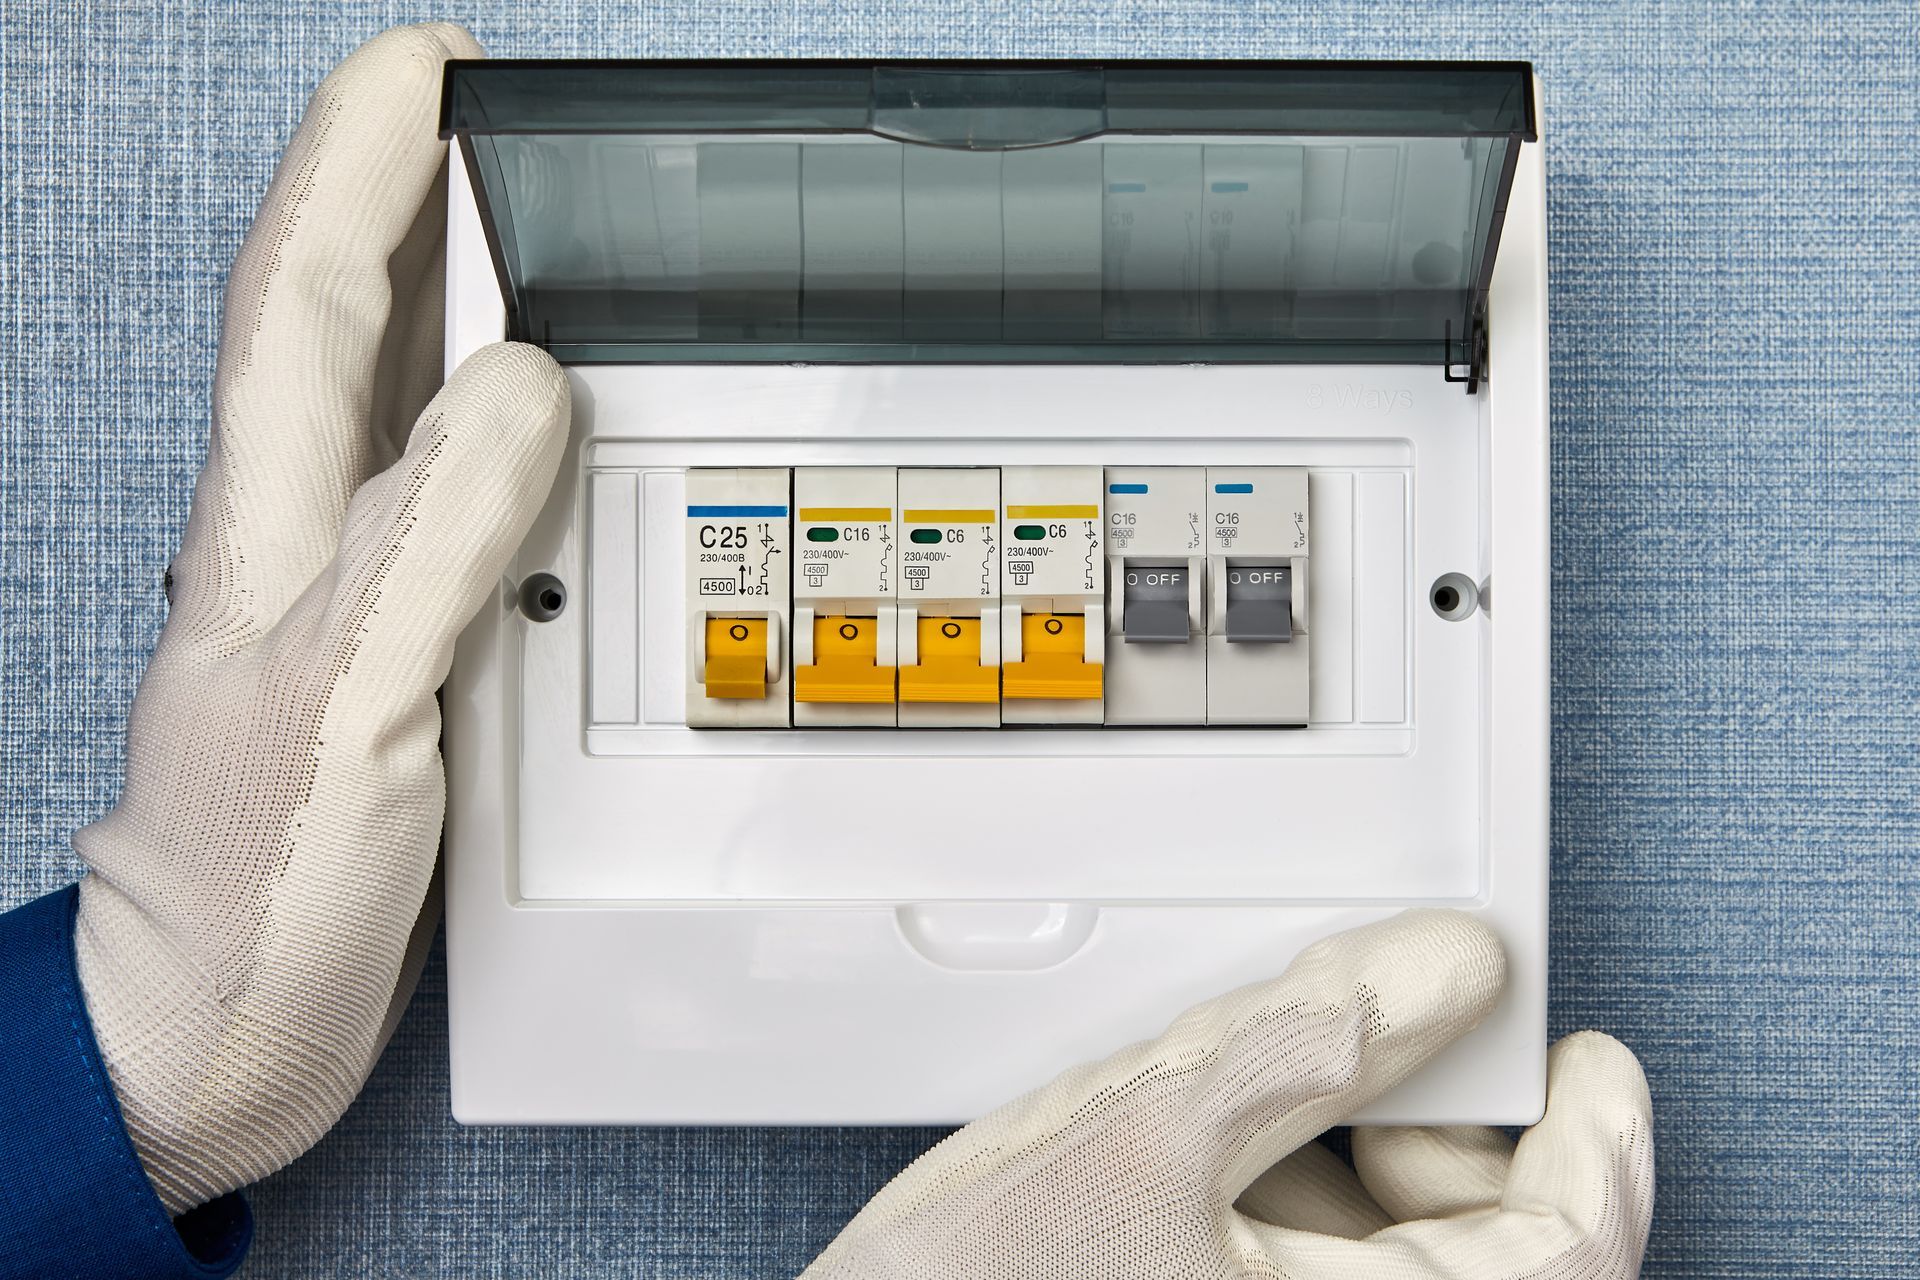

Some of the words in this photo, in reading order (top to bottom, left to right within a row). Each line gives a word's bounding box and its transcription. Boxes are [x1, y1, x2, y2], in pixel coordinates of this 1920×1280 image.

[1306, 384, 1323, 409] 8
[1334, 384, 1413, 416] Ways
[1111, 513, 1137, 525] C16
[1215, 512, 1240, 525] C16
[700, 525, 747, 548] C25
[843, 527, 870, 541] C16
[947, 529, 964, 544] C6
[1049, 524, 1067, 538] C6
[1112, 529, 1133, 538] 4500
[1216, 529, 1236, 537] 4500
[700, 554, 745, 562] 230/400B
[807, 566, 826, 574] 4500
[908, 568, 927, 577] 4500
[1012, 564, 1030, 572] 4500
[1146, 574, 1181, 586] OFF
[1249, 572, 1283, 584] OFF
[703, 582, 733, 592] 4500
[755, 586, 762, 595] 2
